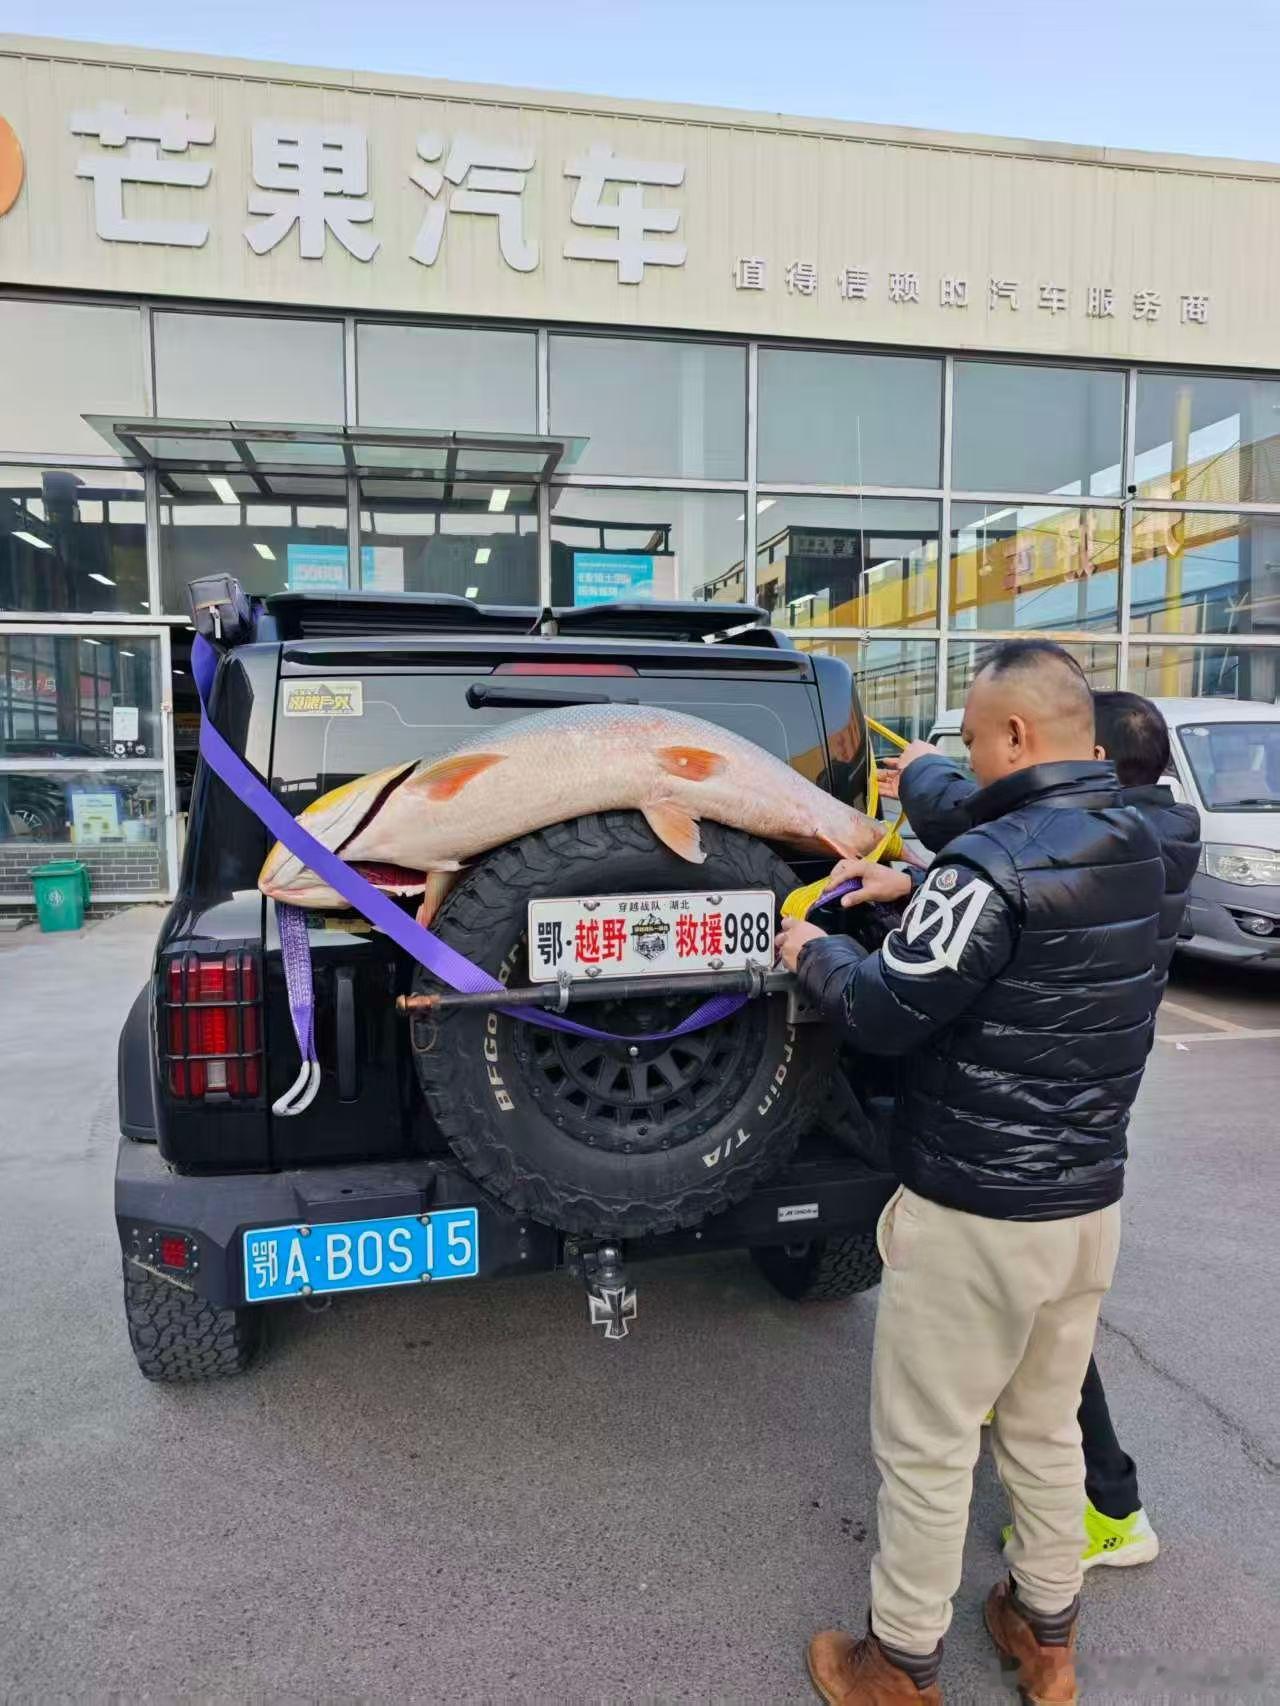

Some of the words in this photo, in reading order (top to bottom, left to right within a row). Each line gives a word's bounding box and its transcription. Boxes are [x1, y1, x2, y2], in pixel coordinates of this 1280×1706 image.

[70, 106, 688, 284] 芒果汽车
[733, 255, 1210, 325] 值得信赖的汽车服务商
[669, 899, 690, 910] 湖北
[702, 1128, 751, 1168] T/A
